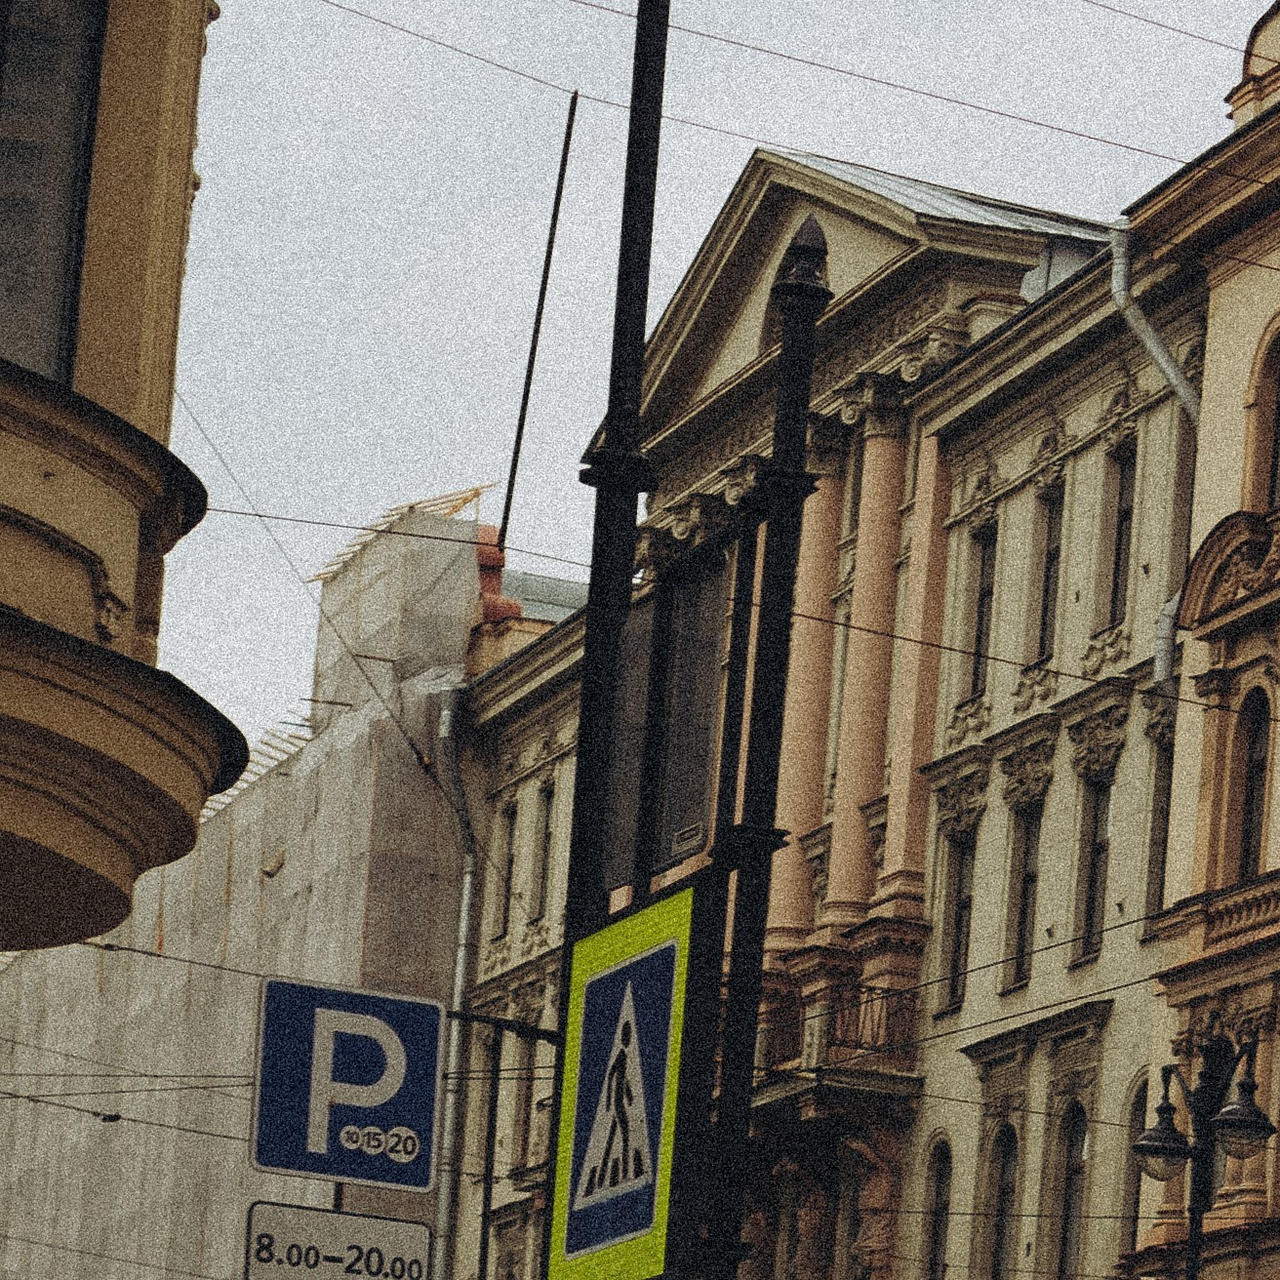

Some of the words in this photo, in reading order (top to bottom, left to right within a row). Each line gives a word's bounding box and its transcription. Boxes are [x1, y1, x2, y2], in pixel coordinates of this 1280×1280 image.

[307, 1007, 407, 1154] P
[363, 1132, 383, 1149] 15
[388, 1133, 417, 1156] 20
